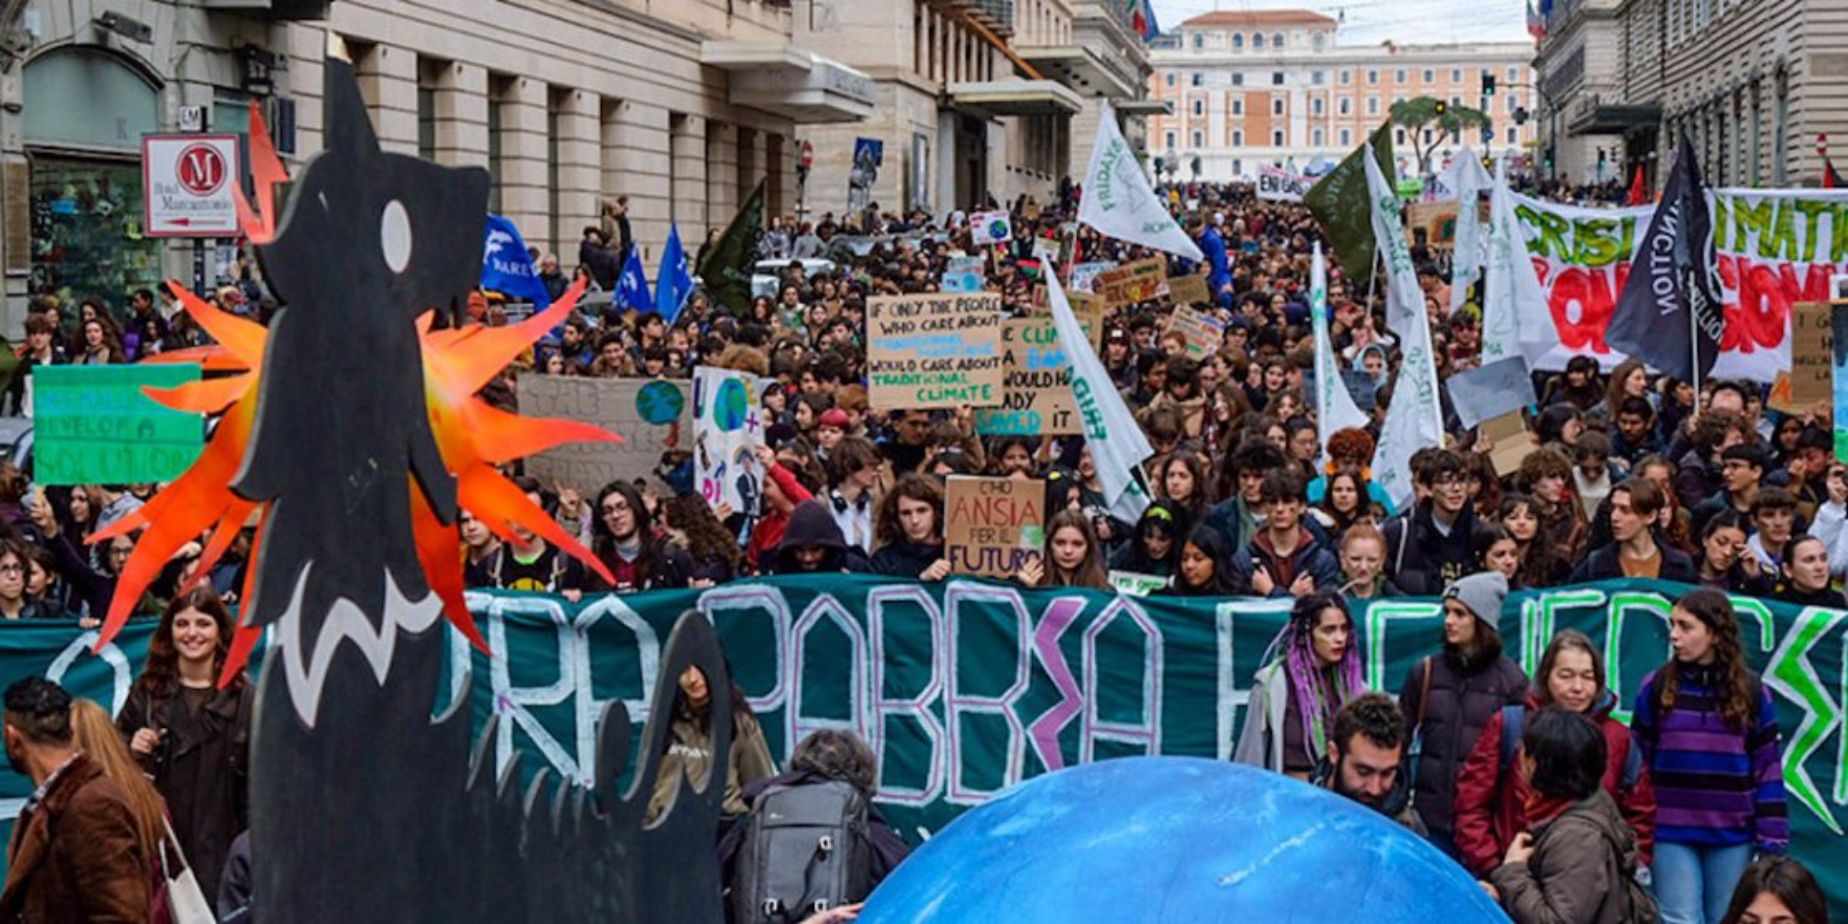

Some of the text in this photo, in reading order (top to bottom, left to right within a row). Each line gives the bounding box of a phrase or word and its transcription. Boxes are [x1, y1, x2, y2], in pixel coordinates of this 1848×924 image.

[188, 153, 215, 187] M
[1096, 139, 1123, 212] FRIDAYS
[870, 297, 1000, 318] IF ONLY THE PEOPLE
[880, 315, 1000, 335] WHO CARE ABOUT
[870, 358, 1000, 372] WOULD CARE ABOUT
[872, 372, 967, 386] TRADITIONAL
[950, 496, 1040, 527] ANSIA
[970, 527, 995, 544] PER
